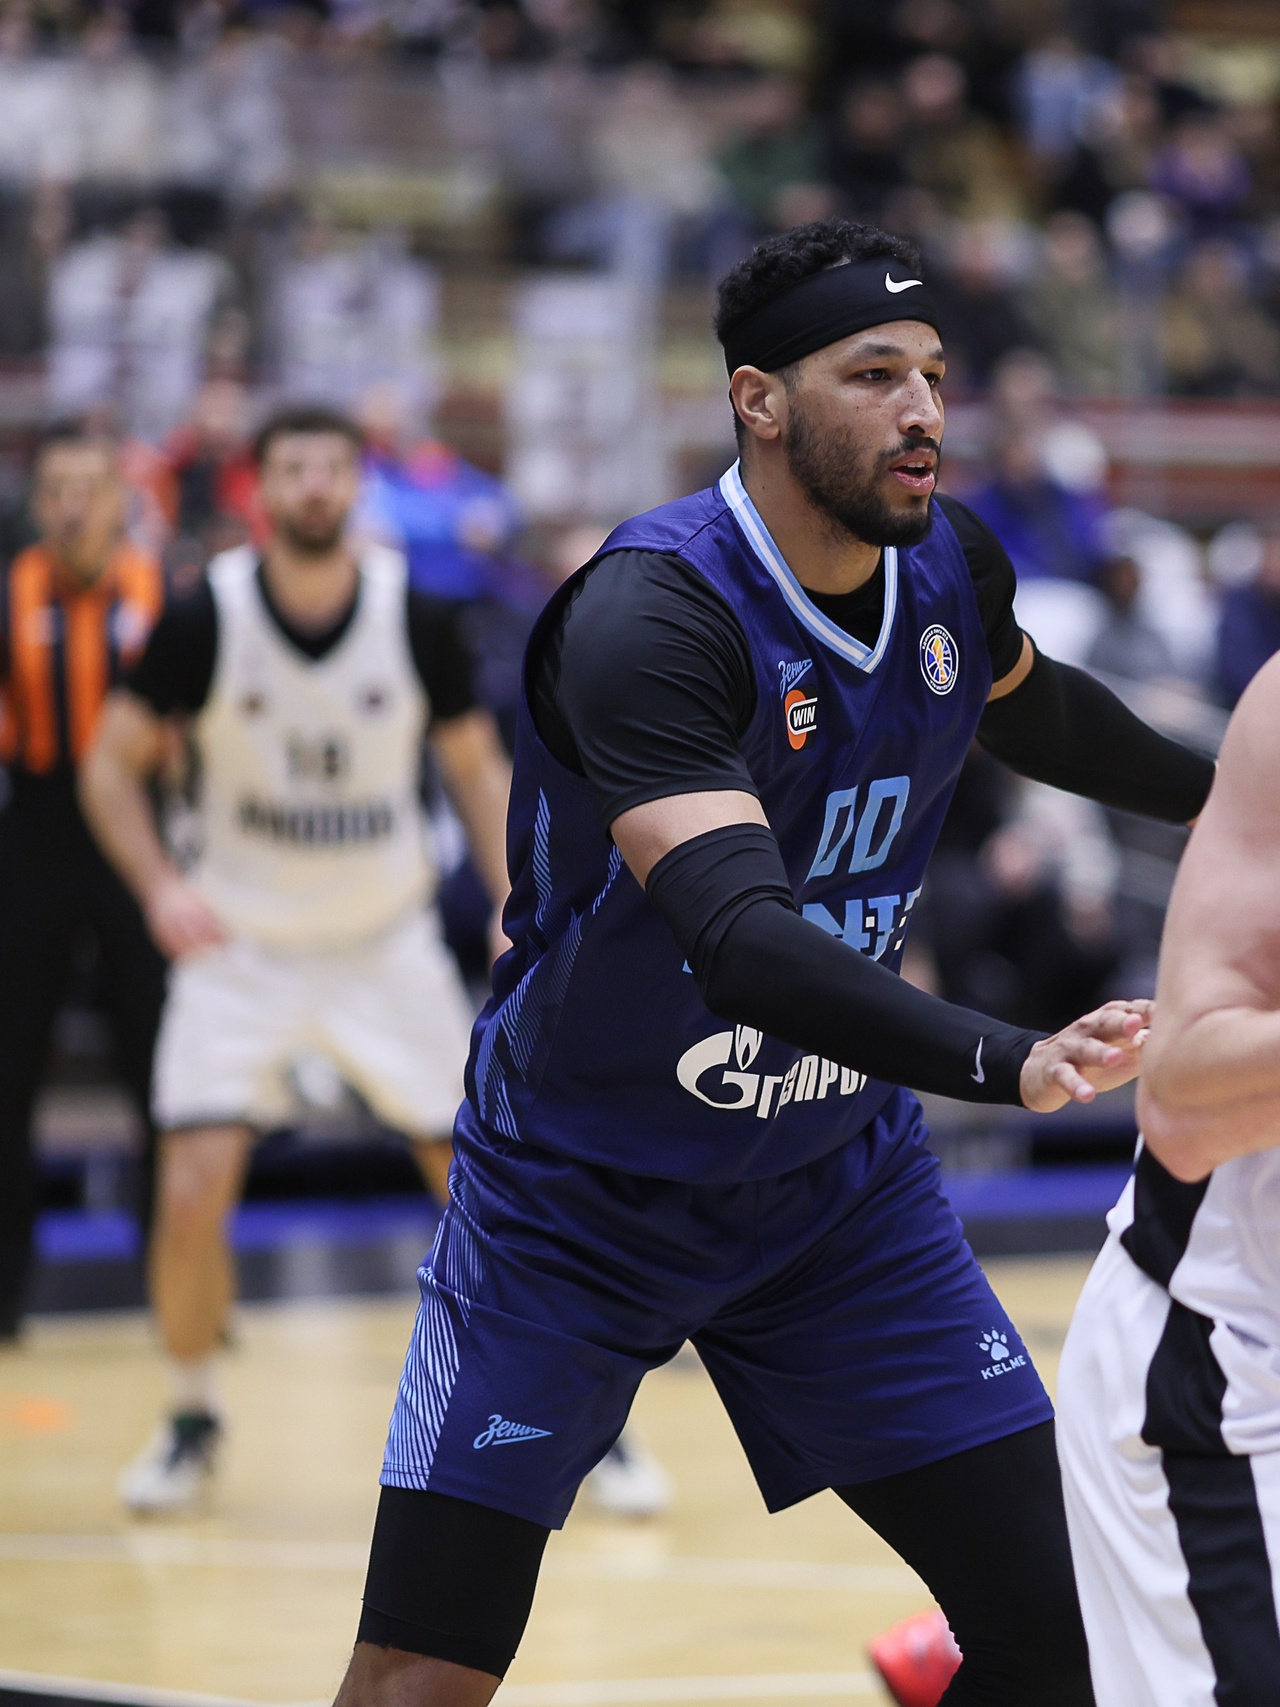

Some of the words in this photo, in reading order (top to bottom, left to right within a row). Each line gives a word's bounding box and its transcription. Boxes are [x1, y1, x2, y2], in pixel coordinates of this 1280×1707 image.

[793, 705, 816, 728] WIN
[805, 775, 911, 885] 00
[980, 1354, 1027, 1380] KELME
[473, 1413, 553, 1449] Зенит
